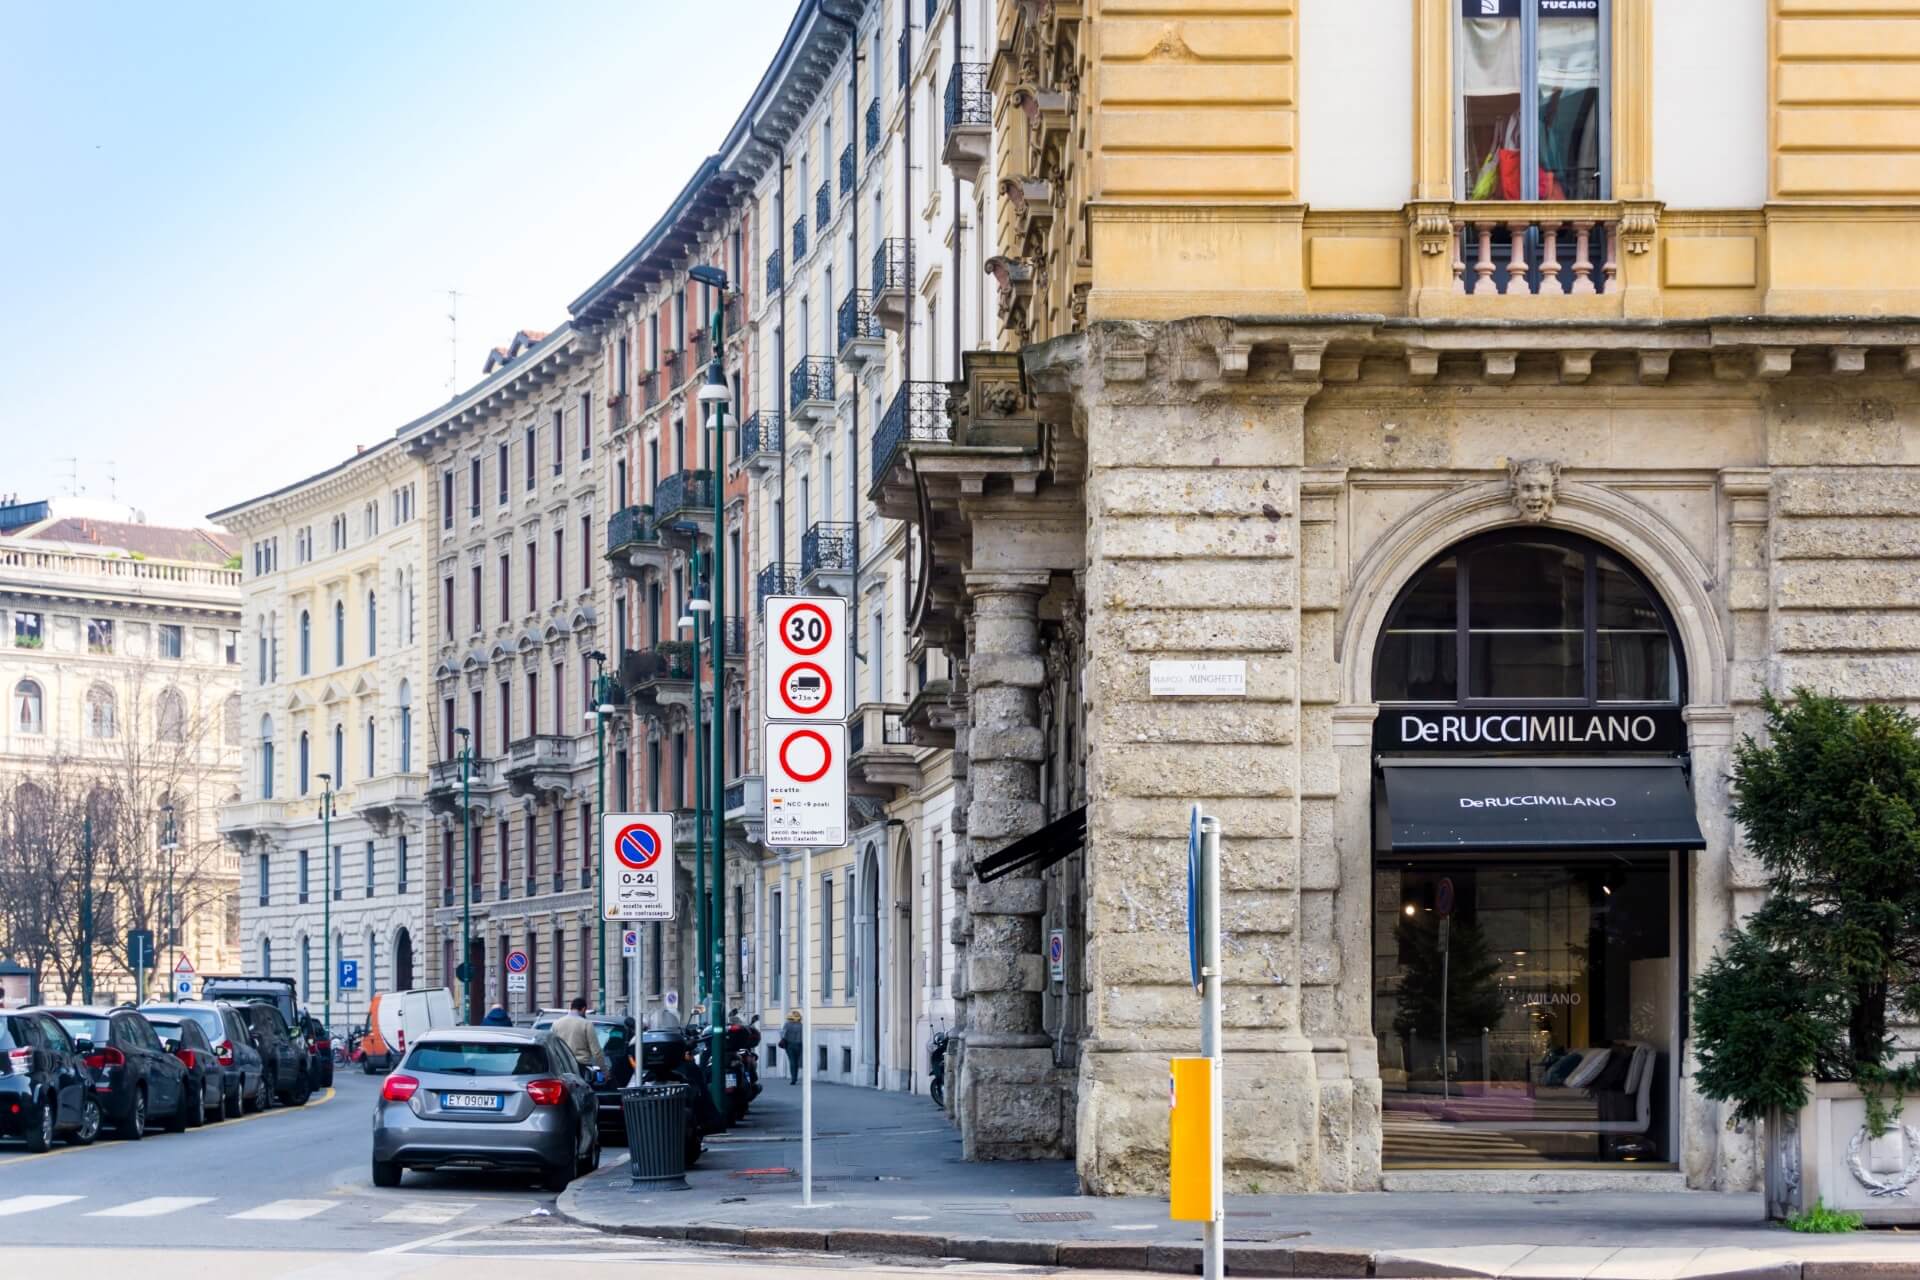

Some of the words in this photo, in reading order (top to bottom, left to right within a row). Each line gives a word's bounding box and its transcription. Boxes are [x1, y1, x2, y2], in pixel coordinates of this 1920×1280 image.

[1541, 1, 1597, 9] TUCANO
[791, 617, 822, 642] 30
[1189, 674, 1243, 684] MINGHETTI
[622, 873, 654, 884] 0-24
[344, 964, 353, 975] P
[1527, 993, 1581, 1005] MILANO
[449, 1095, 462, 1105] EY
